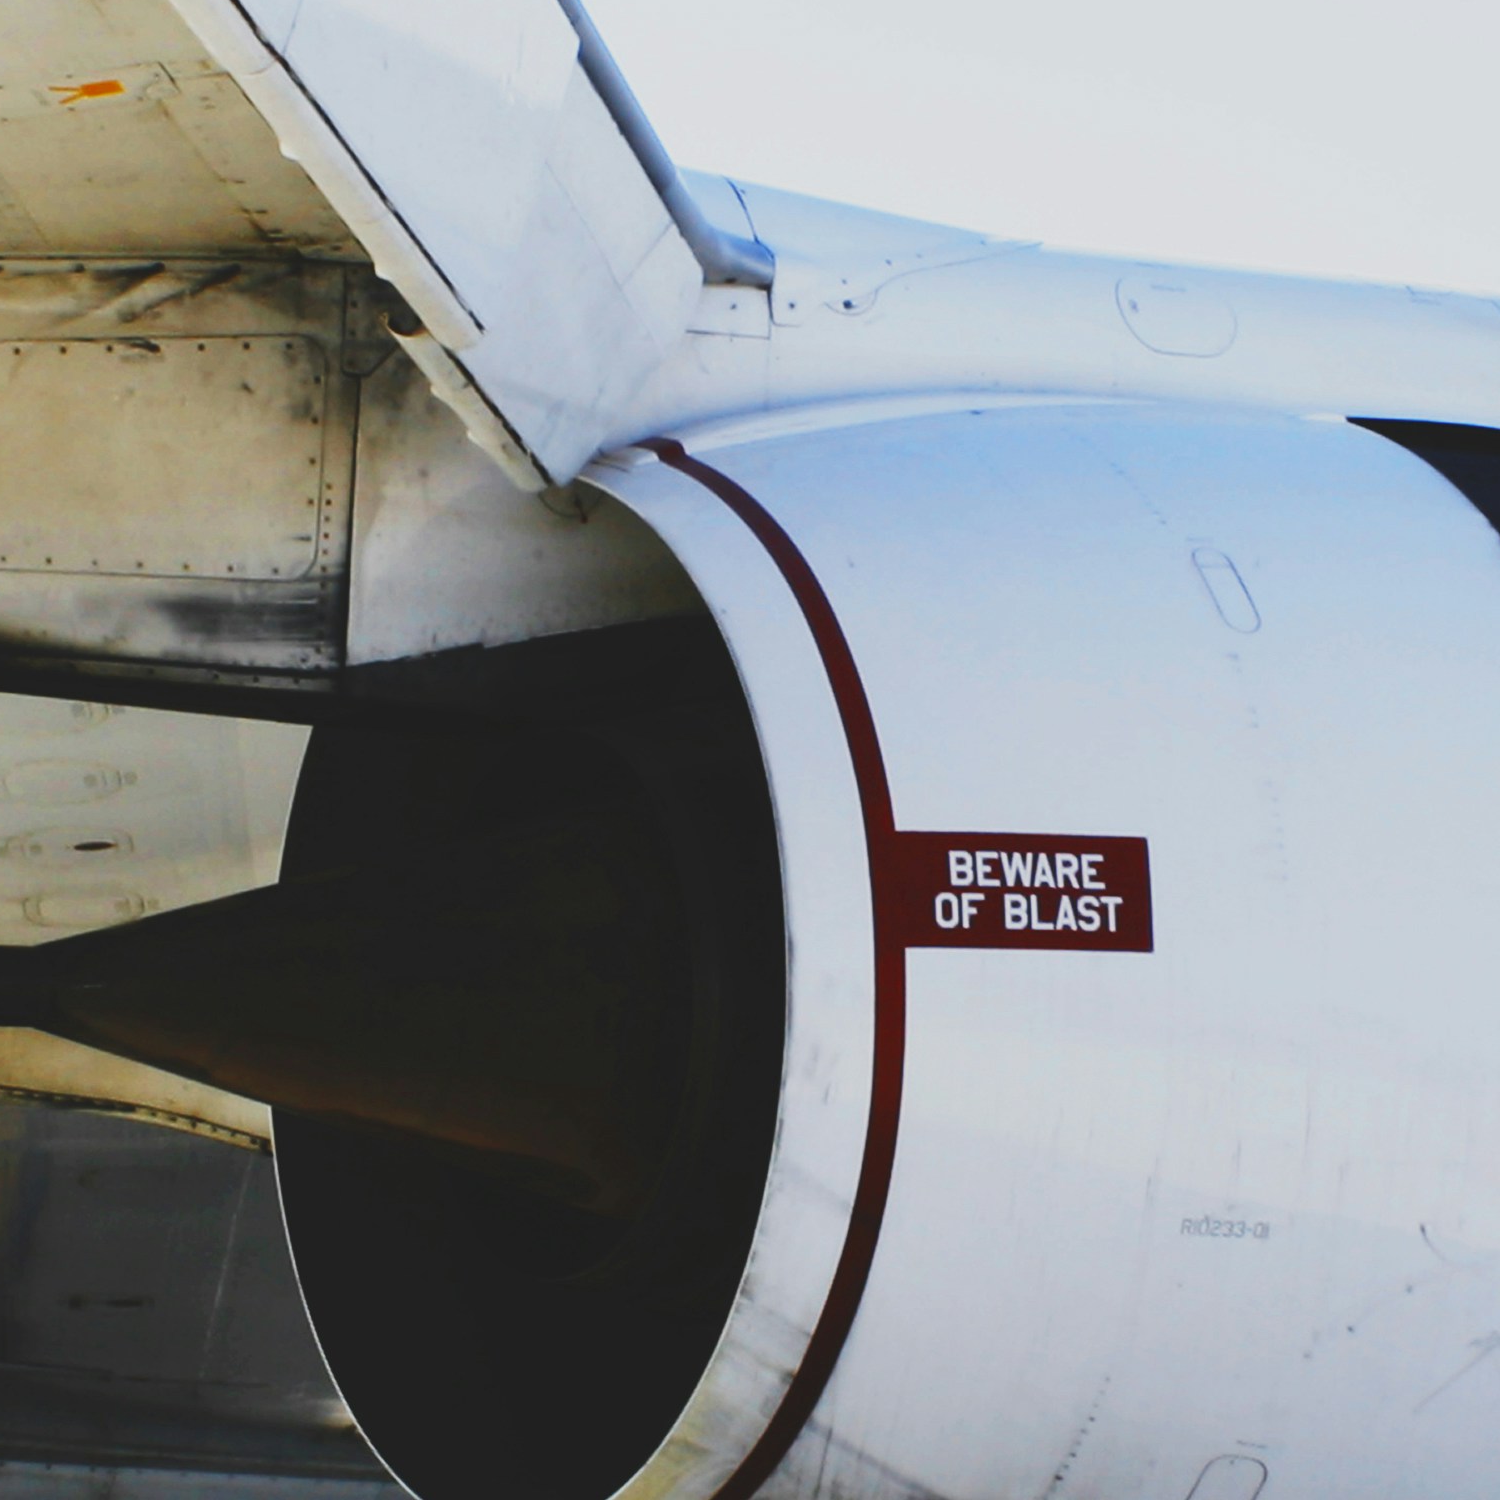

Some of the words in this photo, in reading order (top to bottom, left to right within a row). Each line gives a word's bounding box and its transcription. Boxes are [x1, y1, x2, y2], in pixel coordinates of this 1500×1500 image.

[948, 850, 1106, 890] BEWARE
[934, 892, 986, 929] OF
[1004, 893, 1124, 933] BLAST
